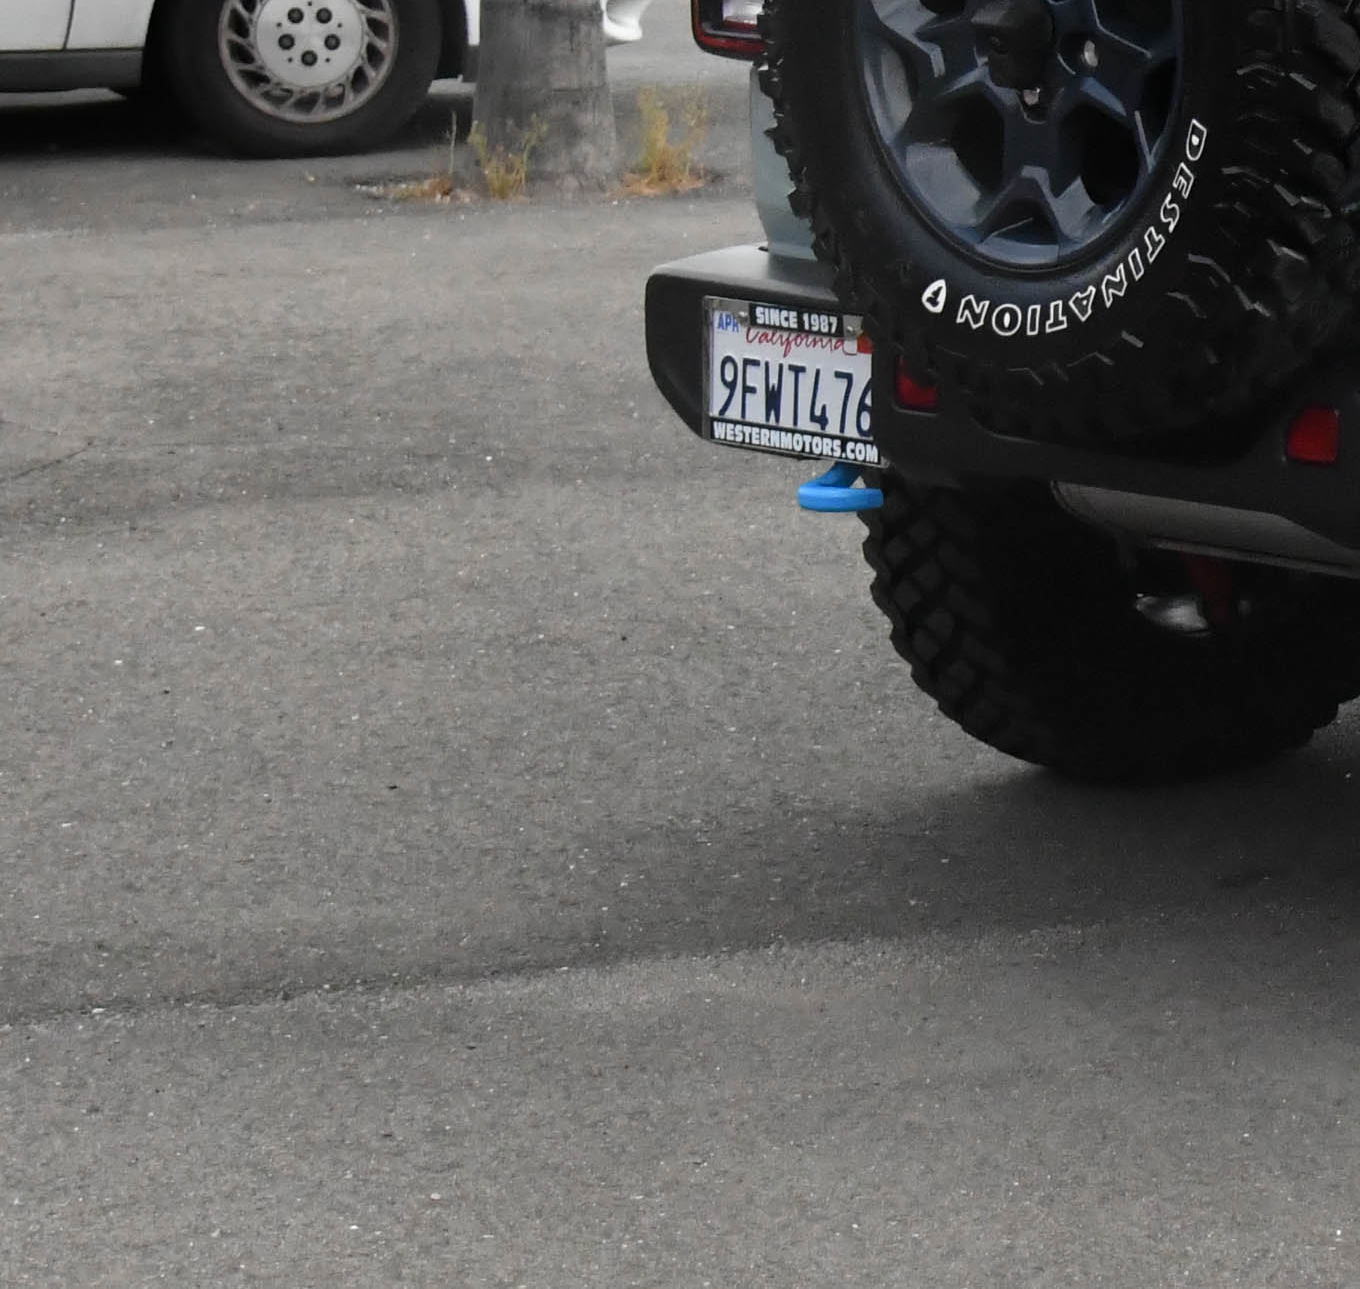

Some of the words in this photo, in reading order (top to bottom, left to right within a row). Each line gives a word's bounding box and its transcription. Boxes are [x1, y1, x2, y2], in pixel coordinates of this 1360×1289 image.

[956, 119, 1208, 337] DESTINATION
[754, 305, 799, 330] SINCE
[802, 312, 839, 335] 1987
[718, 354, 872, 438] 9FWT476
[712, 420, 879, 464] WESTERNMOTORS.COM
